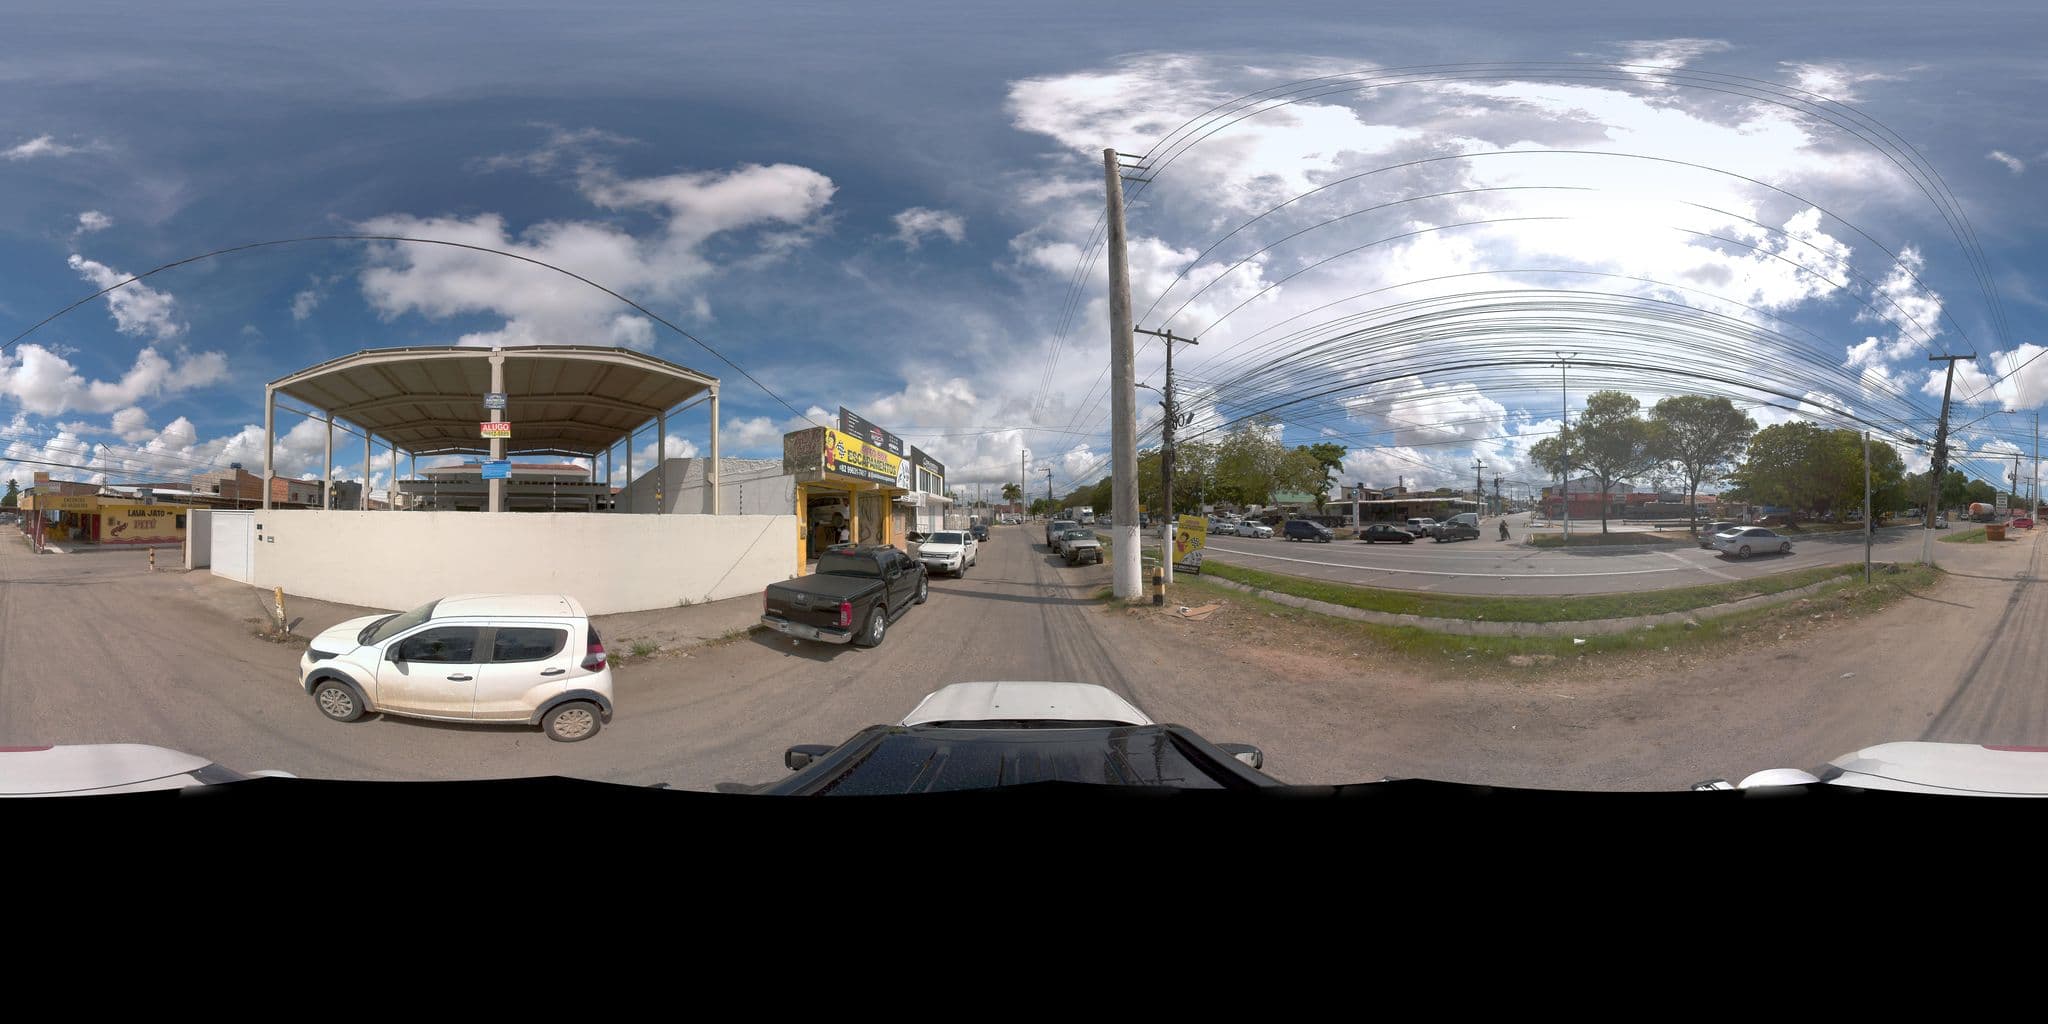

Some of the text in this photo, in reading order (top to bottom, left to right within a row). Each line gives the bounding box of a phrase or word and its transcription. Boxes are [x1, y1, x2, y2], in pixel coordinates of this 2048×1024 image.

[482, 423, 509, 431] ALUGO
[847, 449, 897, 476] ESCAPAMENTOS
[128, 509, 165, 517] LAVA JATO
